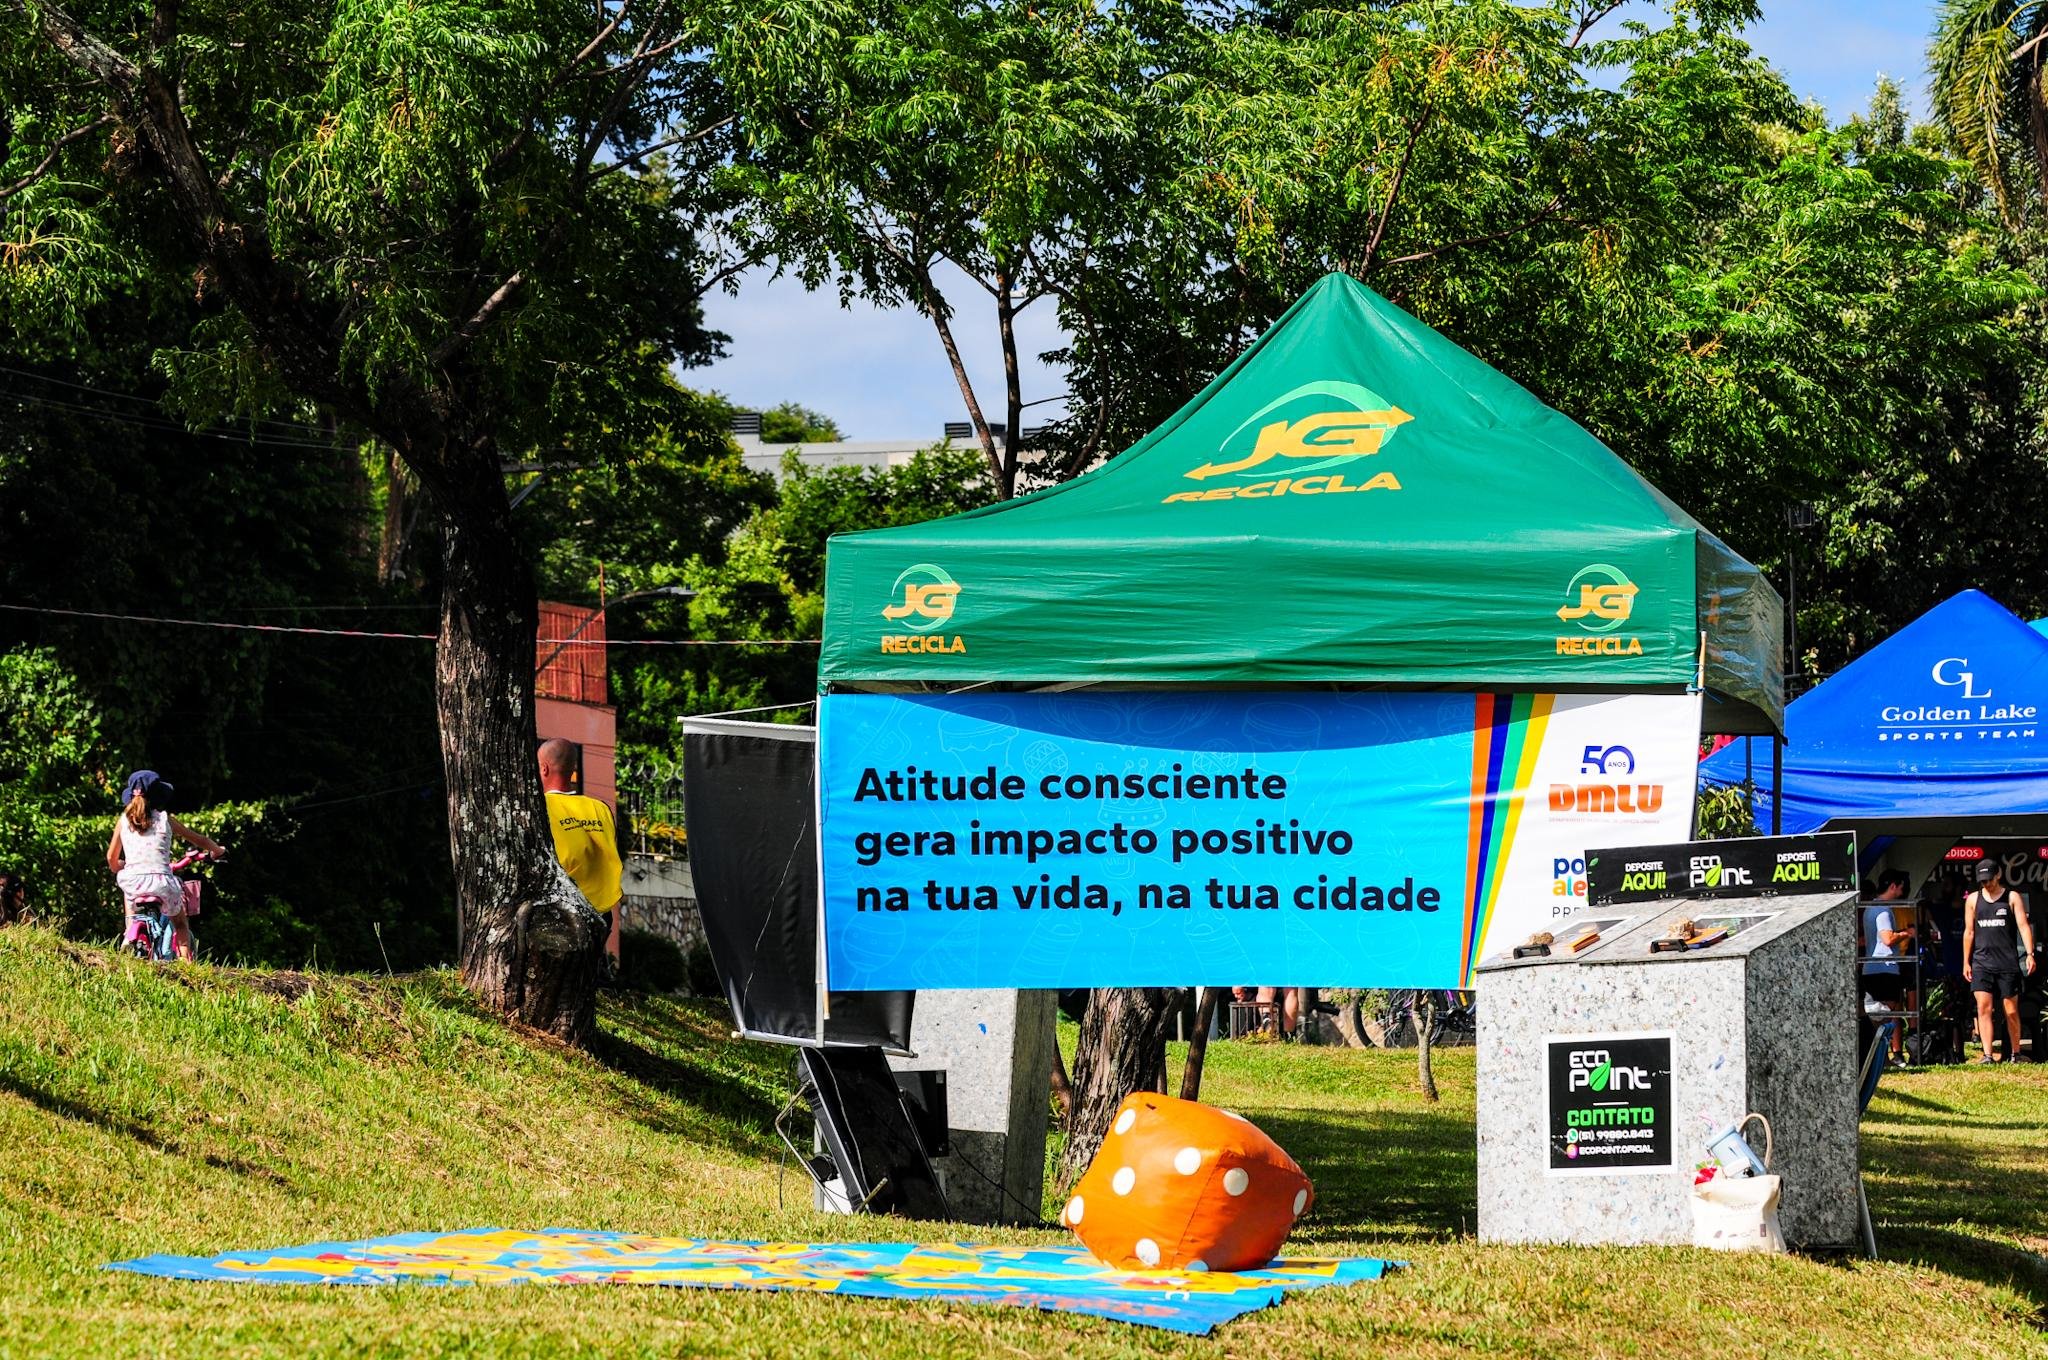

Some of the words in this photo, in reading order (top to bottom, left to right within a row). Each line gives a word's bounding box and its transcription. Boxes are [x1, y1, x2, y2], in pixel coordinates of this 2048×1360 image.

[1183, 405, 1415, 480] JG
[1161, 472, 1402, 503] RECICLA
[881, 580, 962, 621] JG
[1556, 581, 1640, 622] JG
[881, 635, 966, 653] RECICLA
[1556, 637, 1643, 656] RECICLA
[1881, 706, 1971, 722] Golden
[1979, 704, 2037, 720] Lake
[1879, 731, 1963, 741] SPORTS
[1978, 729, 2035, 738] TEAM
[1581, 745, 1635, 774] 50
[854, 766, 1026, 802] Atitude
[1039, 763, 1287, 800] consciente
[1548, 784, 1664, 813] DMLU
[854, 832, 956, 865] gera
[970, 820, 1158, 863] impacto
[1172, 819, 1353, 862] positivo
[1625, 861, 1664, 872] DEPOSITE
[1690, 856, 1720, 870] ECO
[1777, 851, 1816, 863] DEPOSITE
[1620, 871, 1667, 892] AQUI!
[1772, 862, 1820, 882] AQUI!
[857, 886, 909, 912] na
[923, 881, 998, 911] tua
[1012, 874, 1122, 916] vida,
[1139, 884, 1191, 909] na
[1205, 879, 1279, 910] tua
[1293, 875, 1441, 912] cidade
[1569, 1050, 1609, 1068] ECO
[1566, 1106, 1655, 1127] CONTATO
